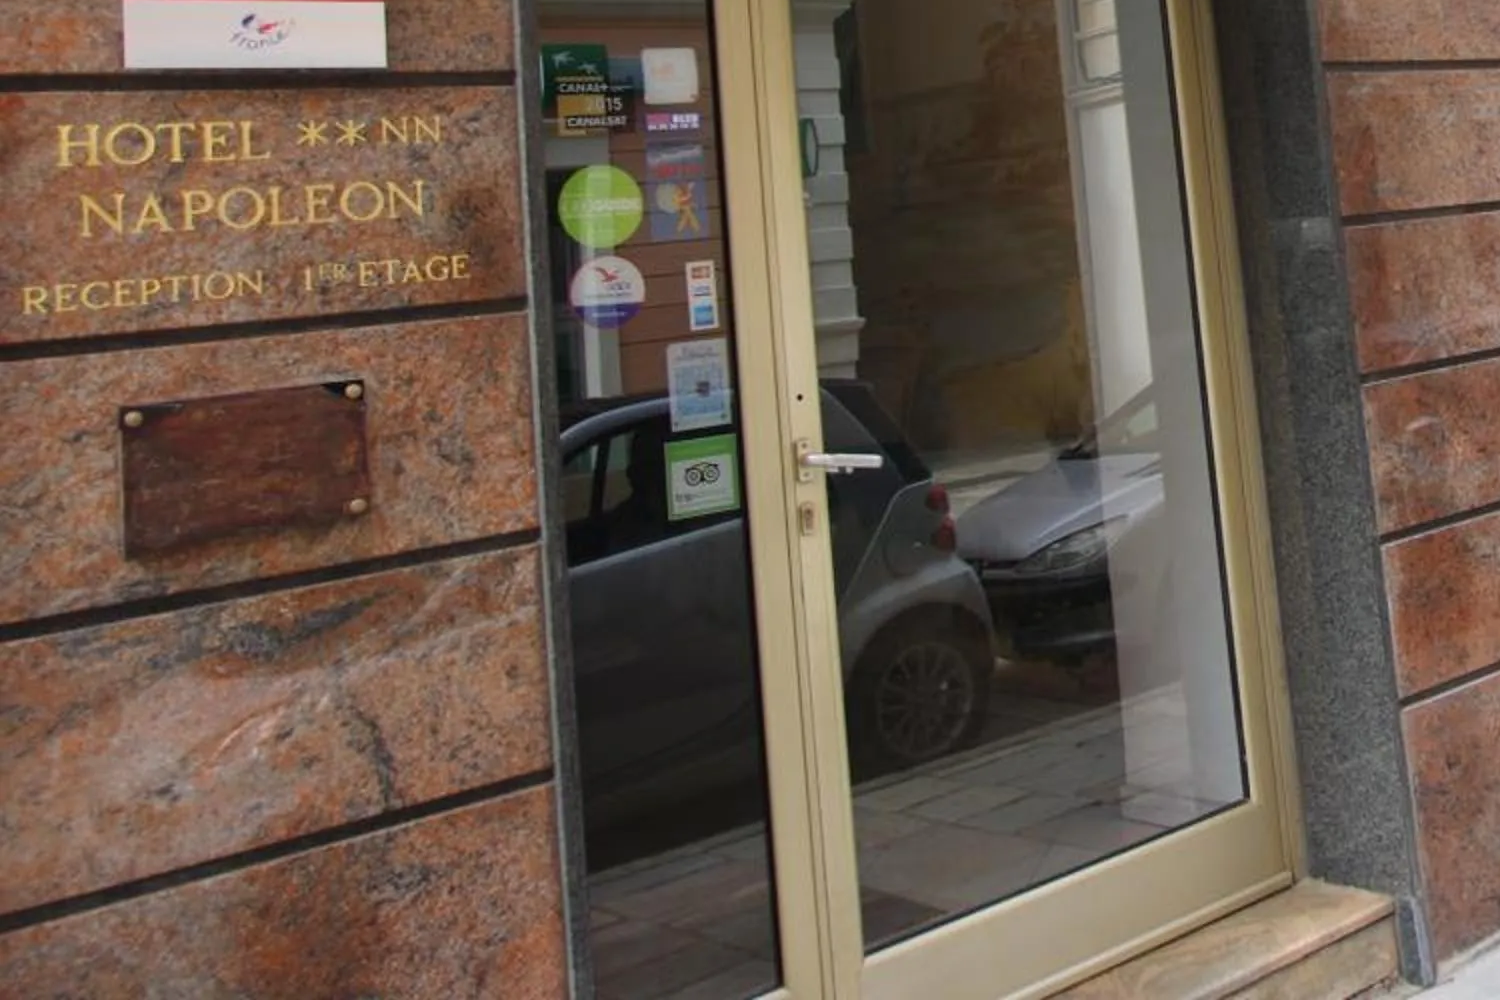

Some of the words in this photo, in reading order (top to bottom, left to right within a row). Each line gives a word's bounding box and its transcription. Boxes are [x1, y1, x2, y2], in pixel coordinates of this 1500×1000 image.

[56, 120, 271, 168] HOTEL
[380, 115, 444, 146] NN
[80, 180, 427, 238] NAPOLEON
[22, 270, 264, 316] RECEPTION
[358, 252, 471, 289] ETAGE
